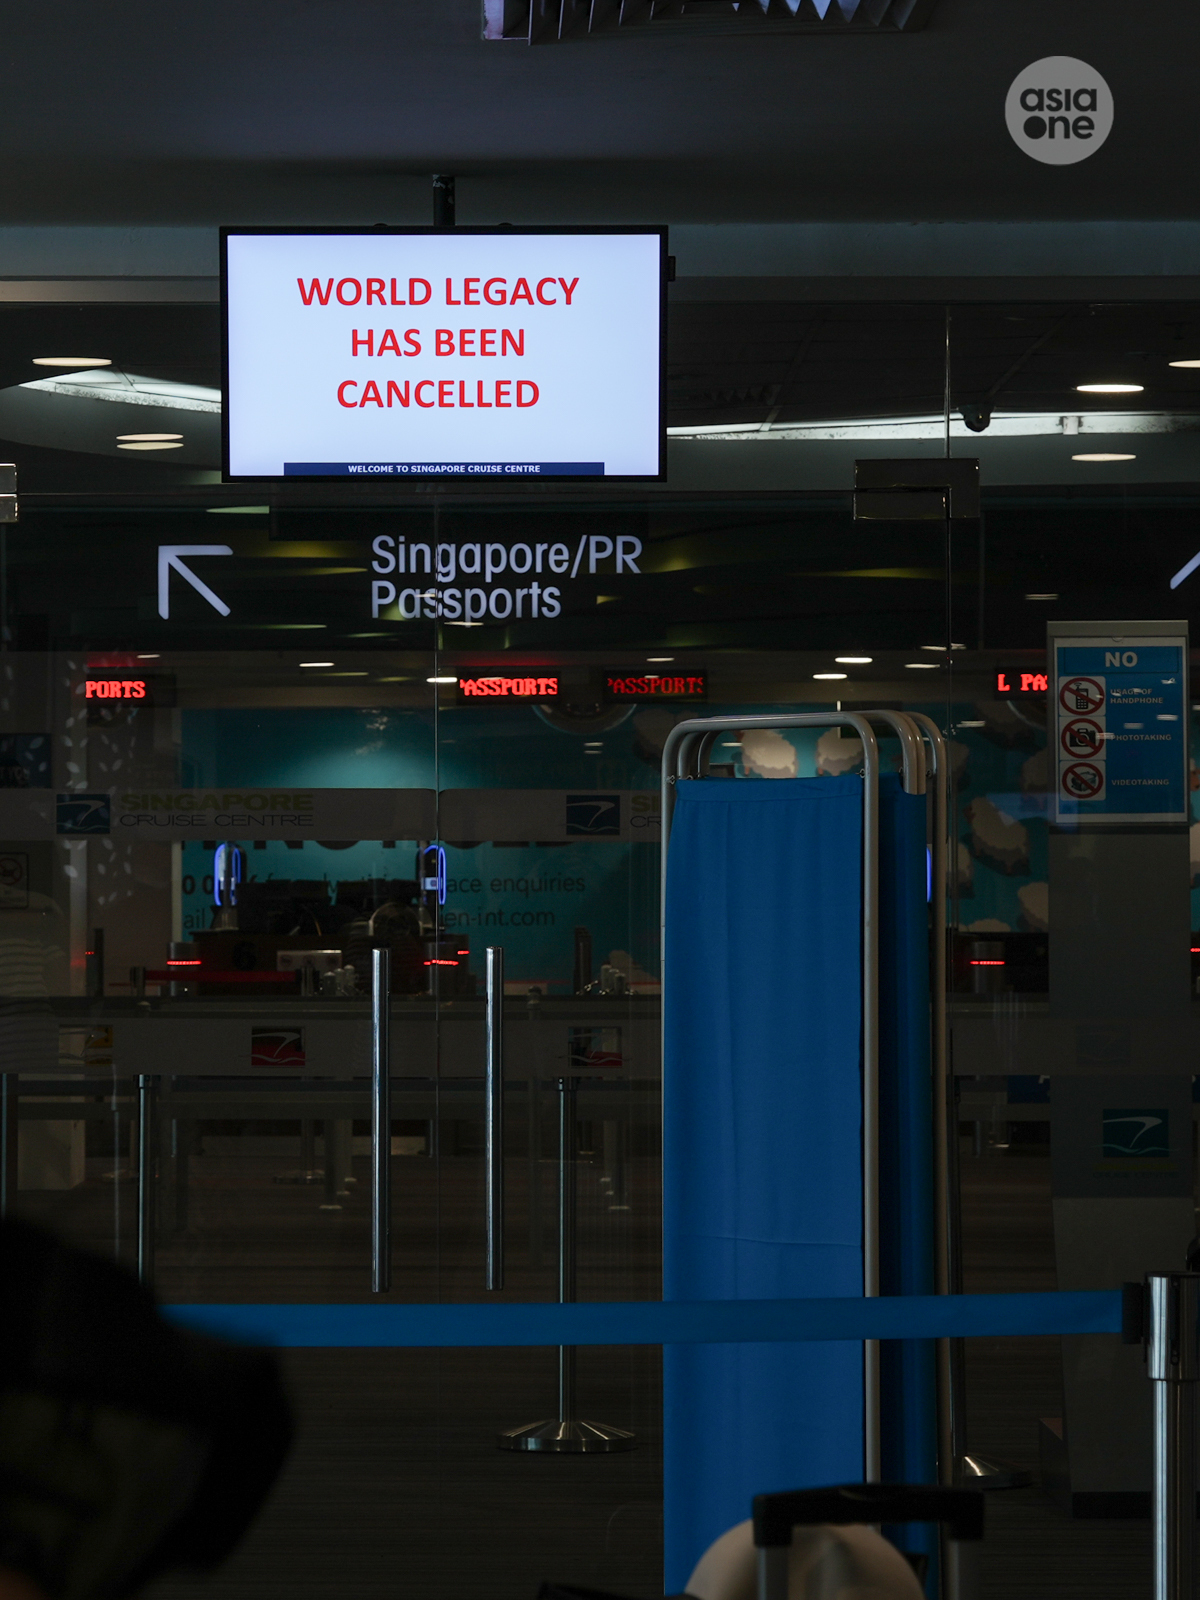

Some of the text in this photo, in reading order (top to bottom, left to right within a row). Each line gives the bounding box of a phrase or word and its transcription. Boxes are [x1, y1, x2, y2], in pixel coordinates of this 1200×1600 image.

[297, 277, 580, 306] WORLD LEGACY
[351, 328, 526, 357] HAS BEEN
[336, 379, 540, 408] CANCELLED
[348, 465, 541, 473] WELCOME TO SINGAPORE CRUISE CENTRE
[371, 534, 643, 583] Singapore/PR
[371, 581, 562, 623] Passports
[1104, 651, 1138, 668] NO
[85, 680, 146, 699] PORTS
[120, 793, 314, 811] SINGAPORE
[631, 795, 659, 812] SI
[119, 814, 314, 827] CRUISE CENTRE
[630, 815, 661, 828] CR
[446, 878, 482, 893] ace
[490, 872, 586, 898] enquiries
